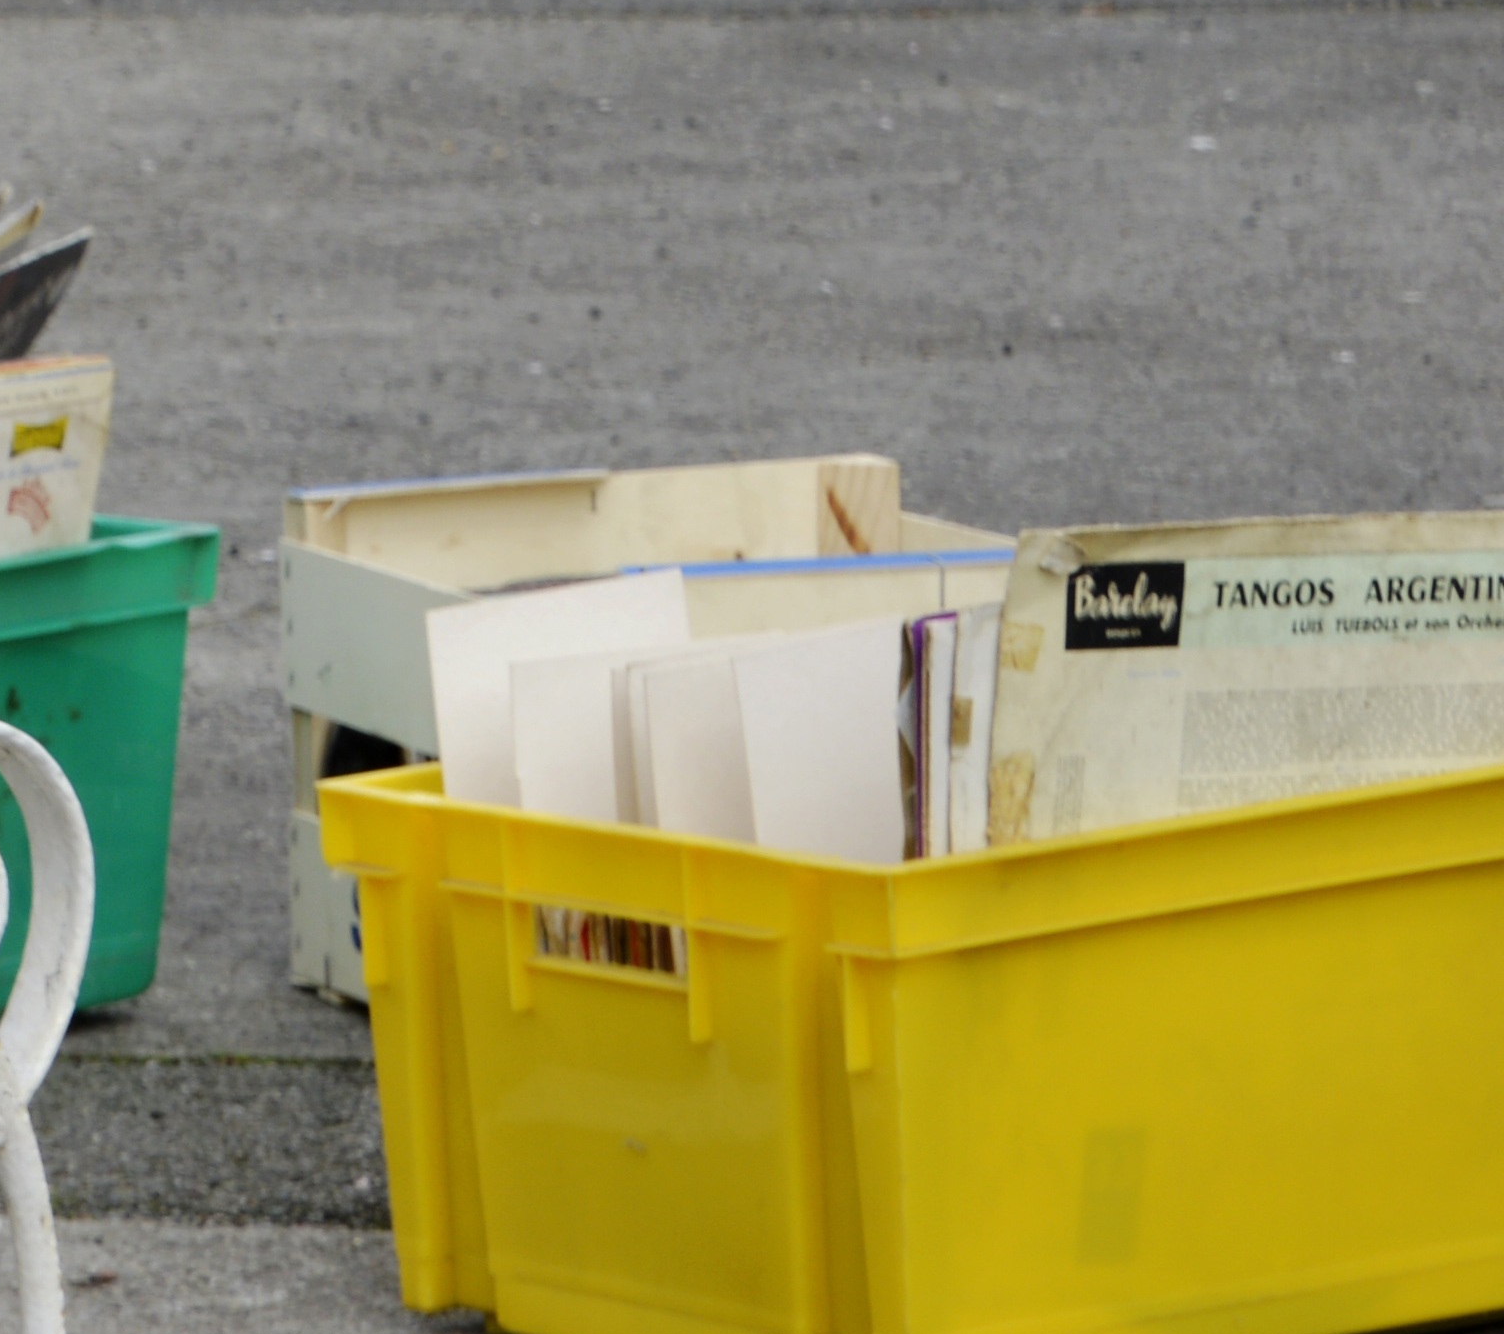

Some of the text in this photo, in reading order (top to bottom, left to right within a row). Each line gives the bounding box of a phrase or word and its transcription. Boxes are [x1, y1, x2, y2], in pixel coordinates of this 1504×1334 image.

[1075, 571, 1177, 632] Barclay
[1214, 578, 1335, 608] TANGOS
[1292, 619, 1323, 634] LUIS
